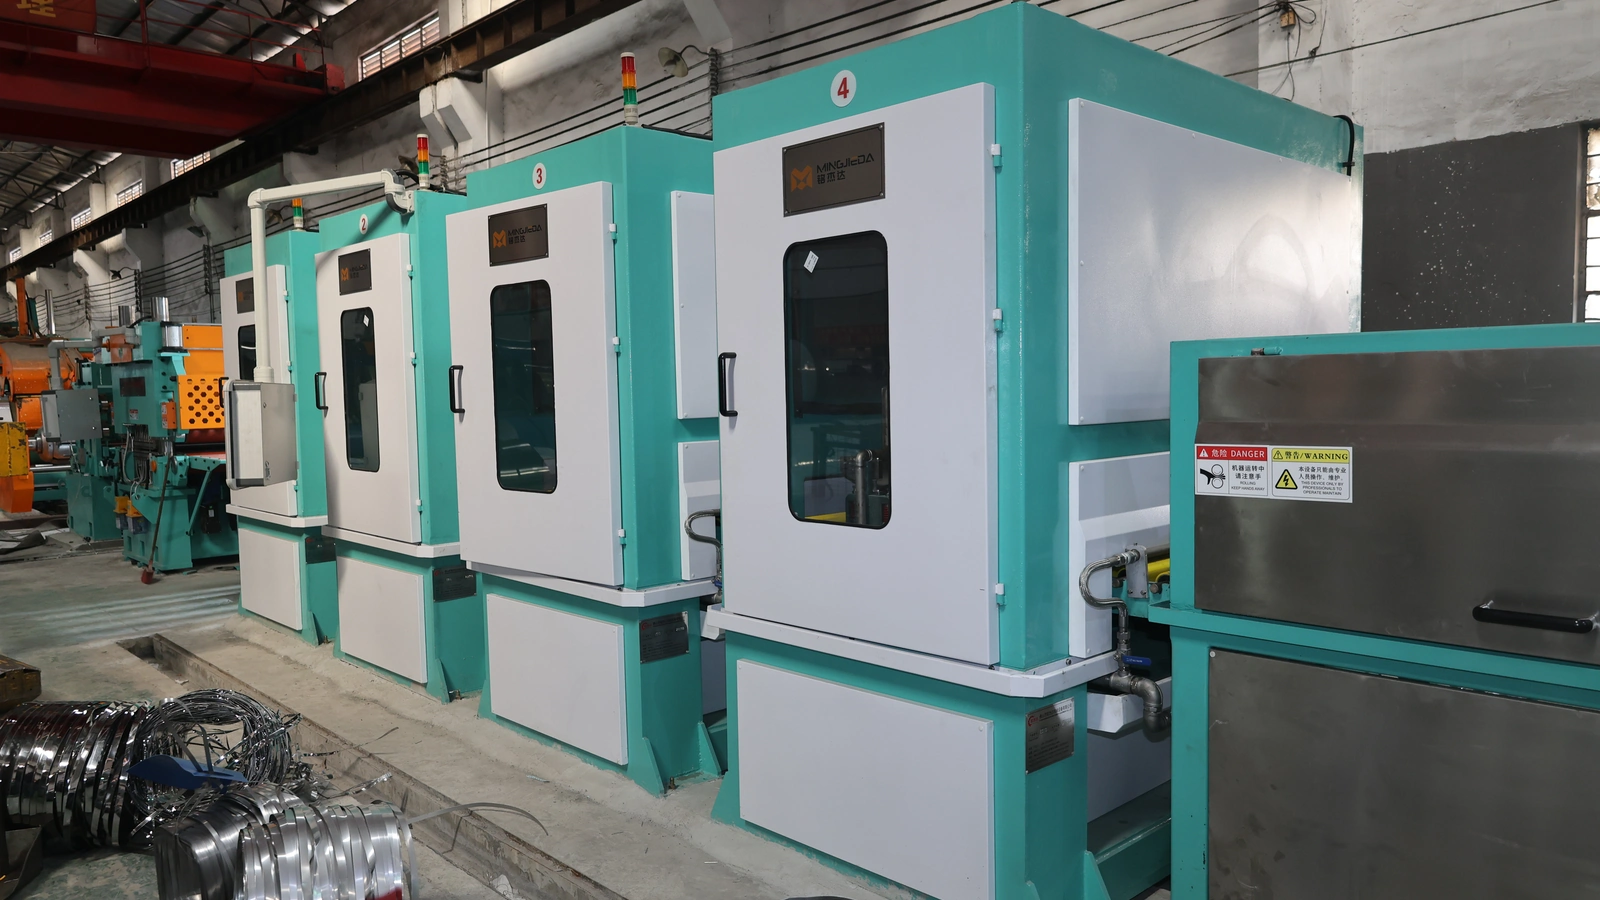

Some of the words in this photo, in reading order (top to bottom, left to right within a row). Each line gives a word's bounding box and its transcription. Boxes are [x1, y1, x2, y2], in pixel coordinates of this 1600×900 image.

[837, 77, 850, 99] 4
[816, 153, 875, 174] MINGJIEDA
[536, 167, 543, 184] 3
[361, 217, 367, 231] 2
[507, 224, 543, 237] MINGJIEDA
[1211, 449, 1228, 458] 危险
[1230, 450, 1265, 458] DANGER
[1298, 466, 1347, 474] 本设备只能由专业
